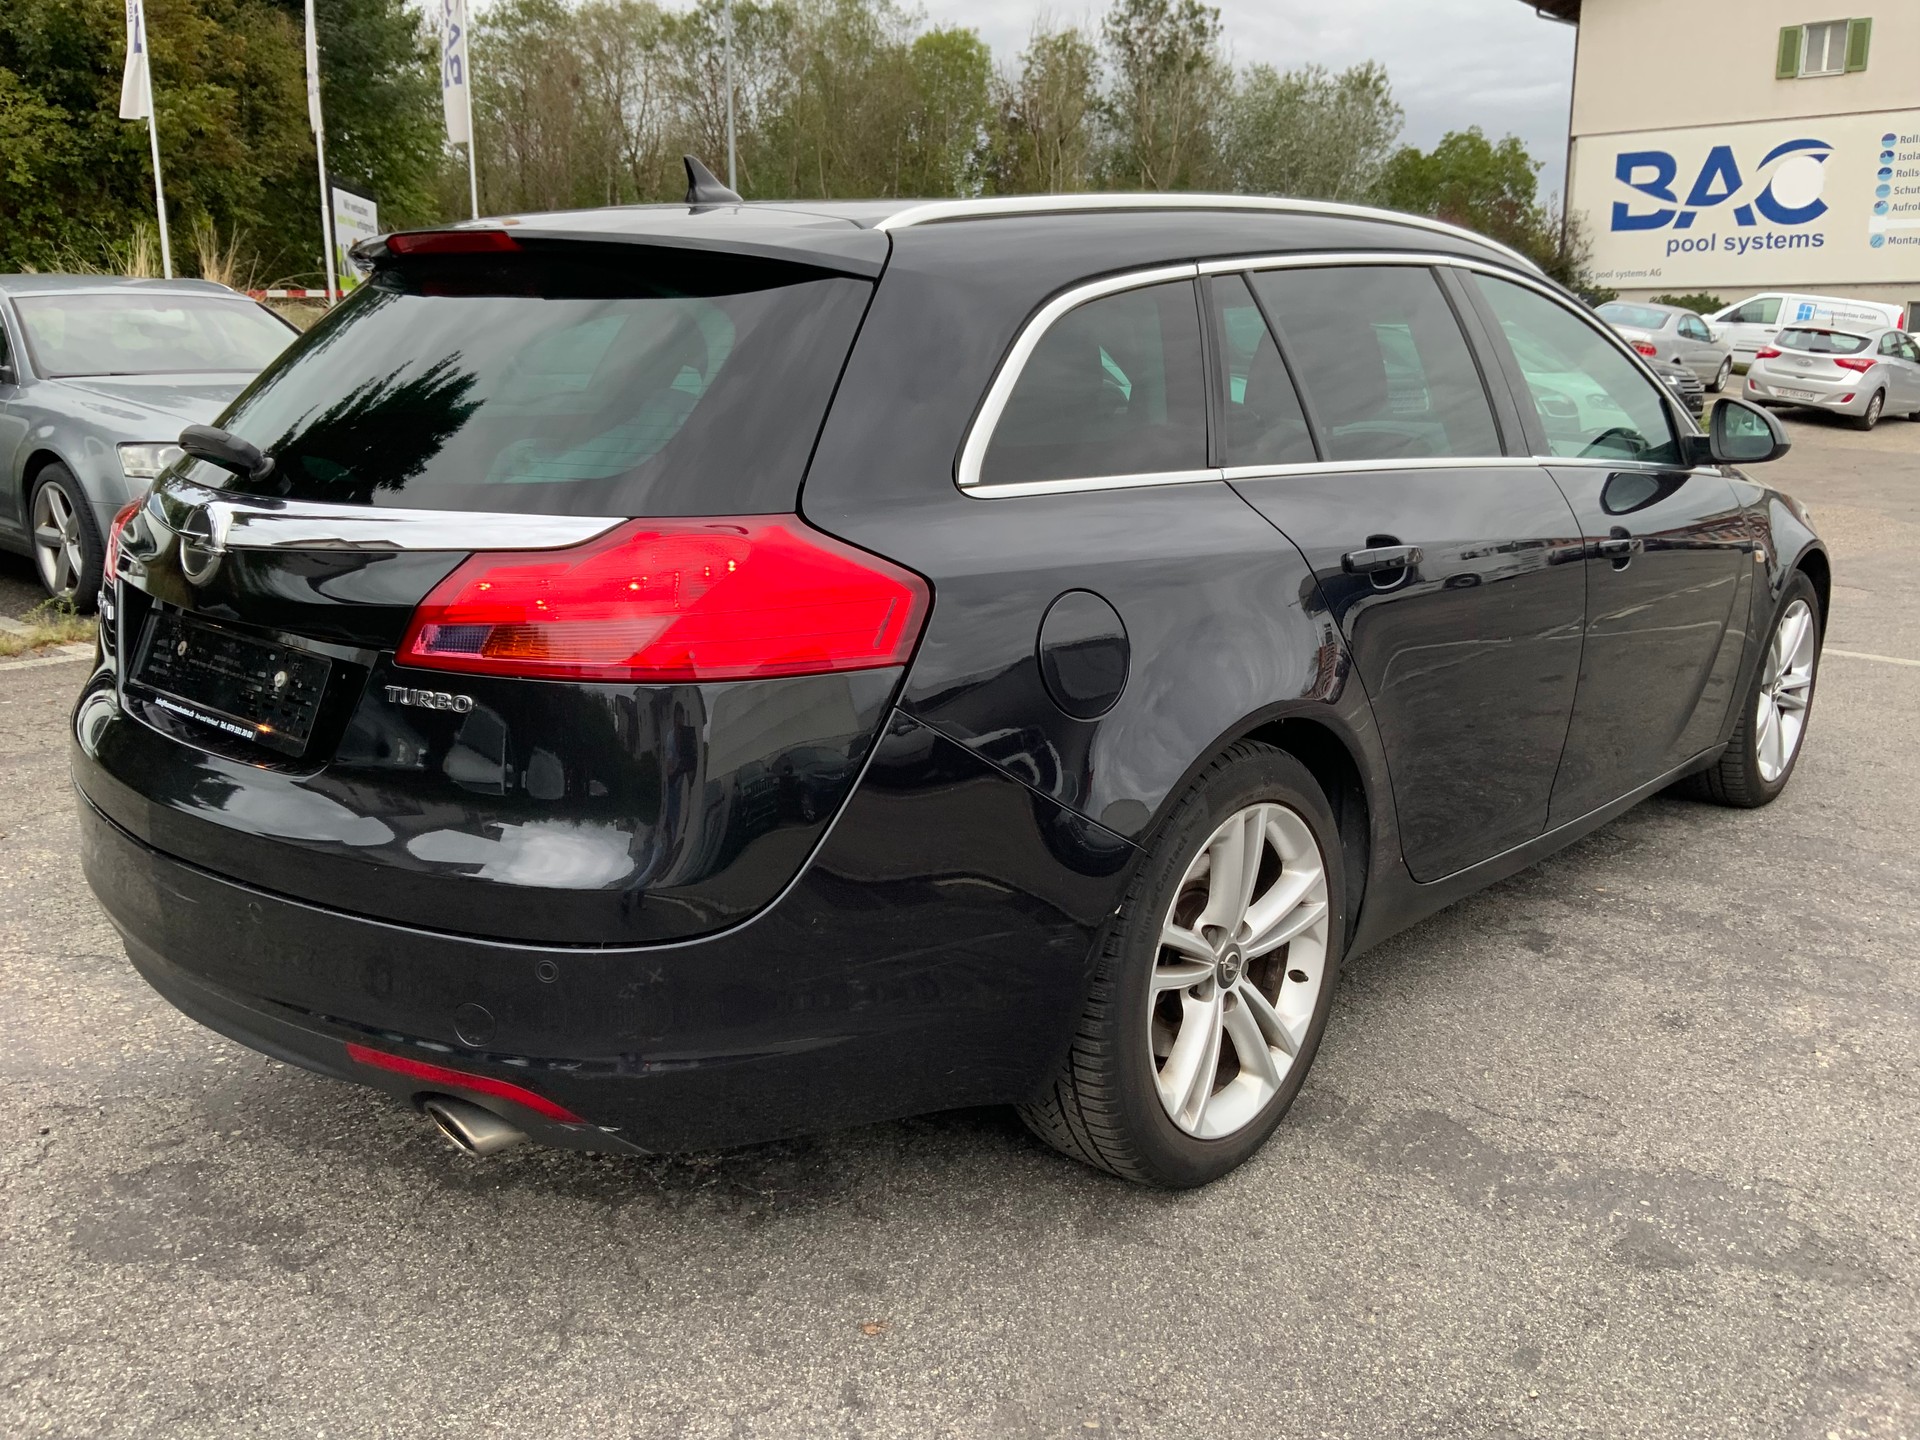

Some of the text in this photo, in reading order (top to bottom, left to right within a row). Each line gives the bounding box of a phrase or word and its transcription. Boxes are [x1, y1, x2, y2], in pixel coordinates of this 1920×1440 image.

[1900, 134, 1920, 144] Roll
[1611, 138, 1834, 232] BAC
[1666, 232, 1824, 257] pool systems
[1595, 269, 1614, 280] pool
[1615, 269, 1647, 280] systems
[1648, 268, 1662, 277] AG
[385, 685, 473, 713] TURBO
